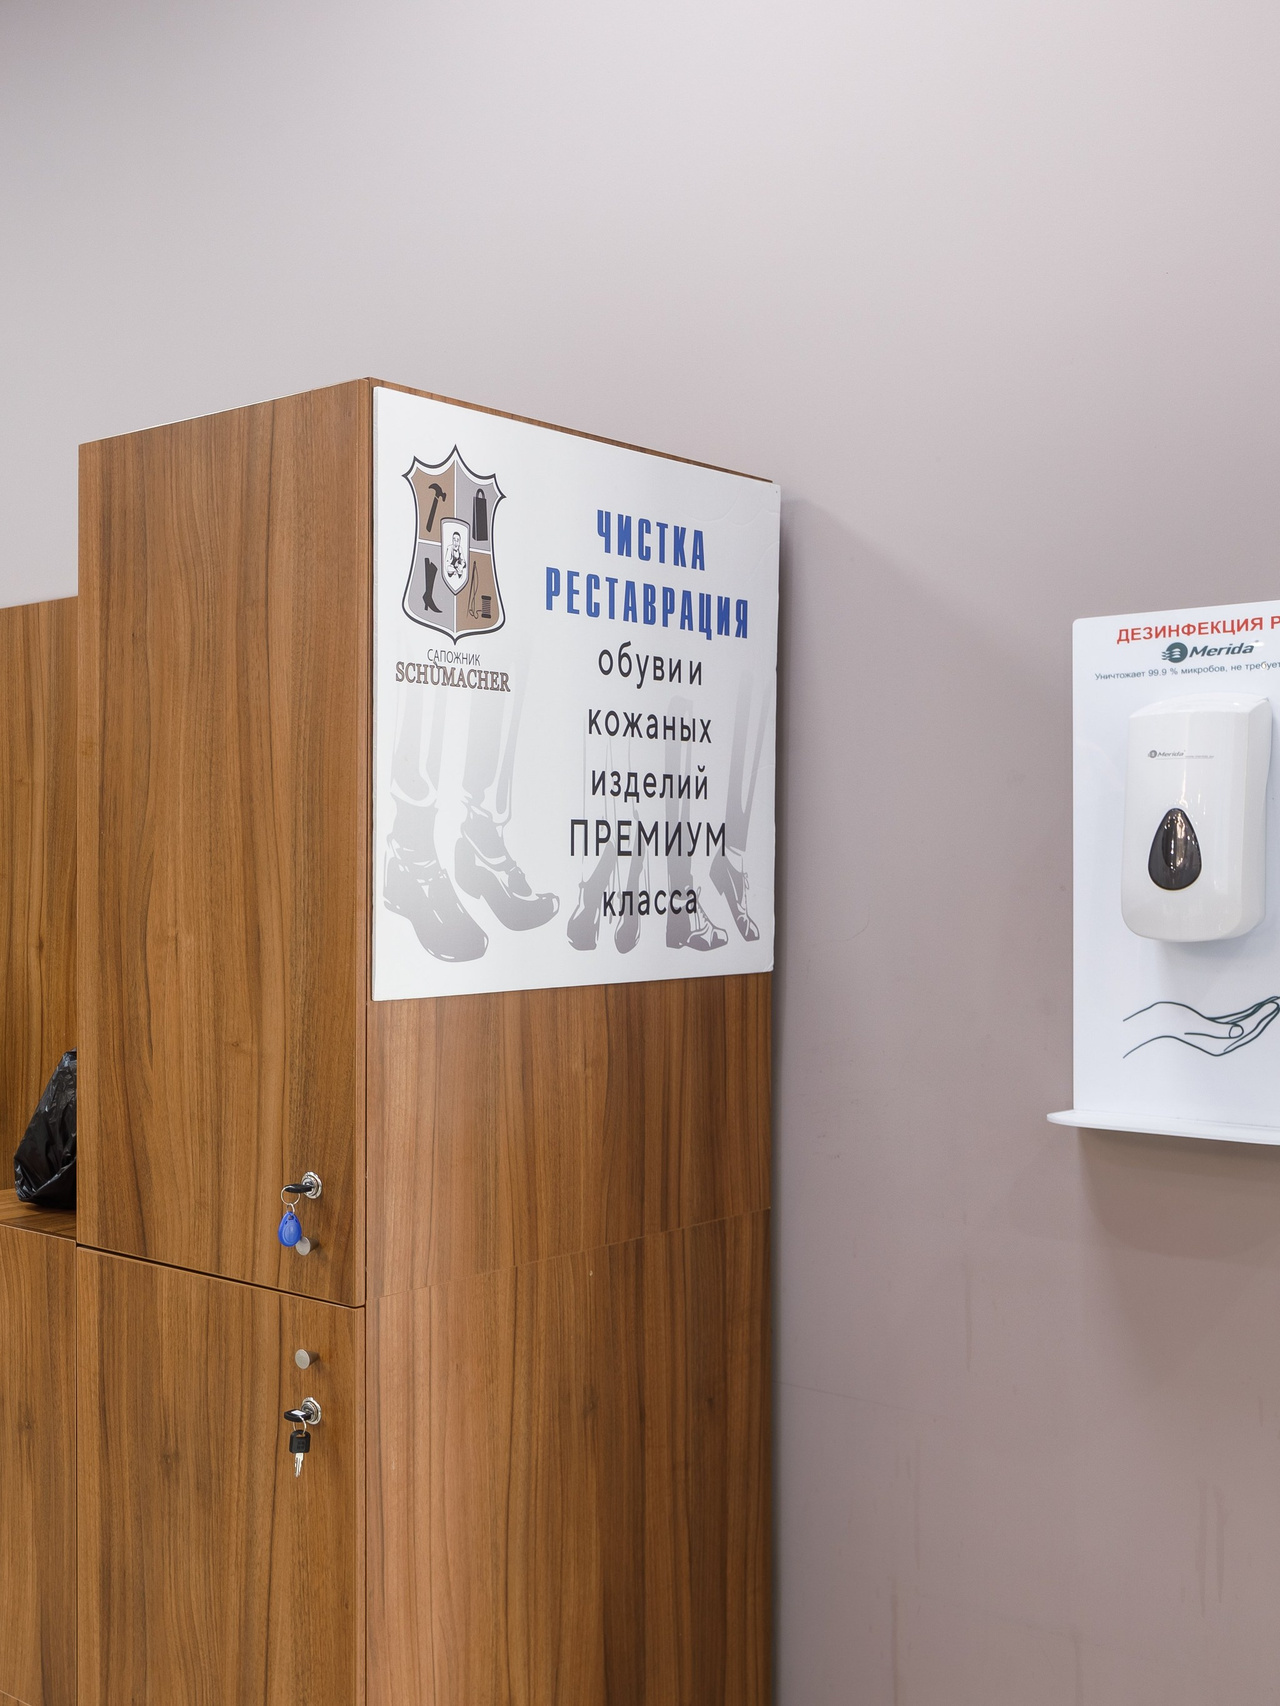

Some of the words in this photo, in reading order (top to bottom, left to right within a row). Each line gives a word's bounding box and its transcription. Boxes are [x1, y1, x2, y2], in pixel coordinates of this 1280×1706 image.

[597, 509, 705, 571] ЧИСТКА
[545, 566, 748, 641] РЕСТАВРАЦИЯ
[1116, 617, 1263, 644] ДЕЗИНФЕКЦИЯ
[426, 648, 481, 667] САПОЖНИК
[1189, 643, 1255, 657] Merida
[395, 660, 511, 692] SCHUMACHER
[1094, 670, 1146, 681] Уничтожает
[1148, 668, 1167, 677] 99.9
[1169, 667, 1179, 676] %
[1180, 664, 1228, 676] микробов,
[1230, 664, 1243, 672] не
[588, 708, 712, 743] кожаных
[591, 764, 708, 803] изделий
[570, 818, 726, 857] ПРЕМИУМ
[602, 888, 698, 917] класса
